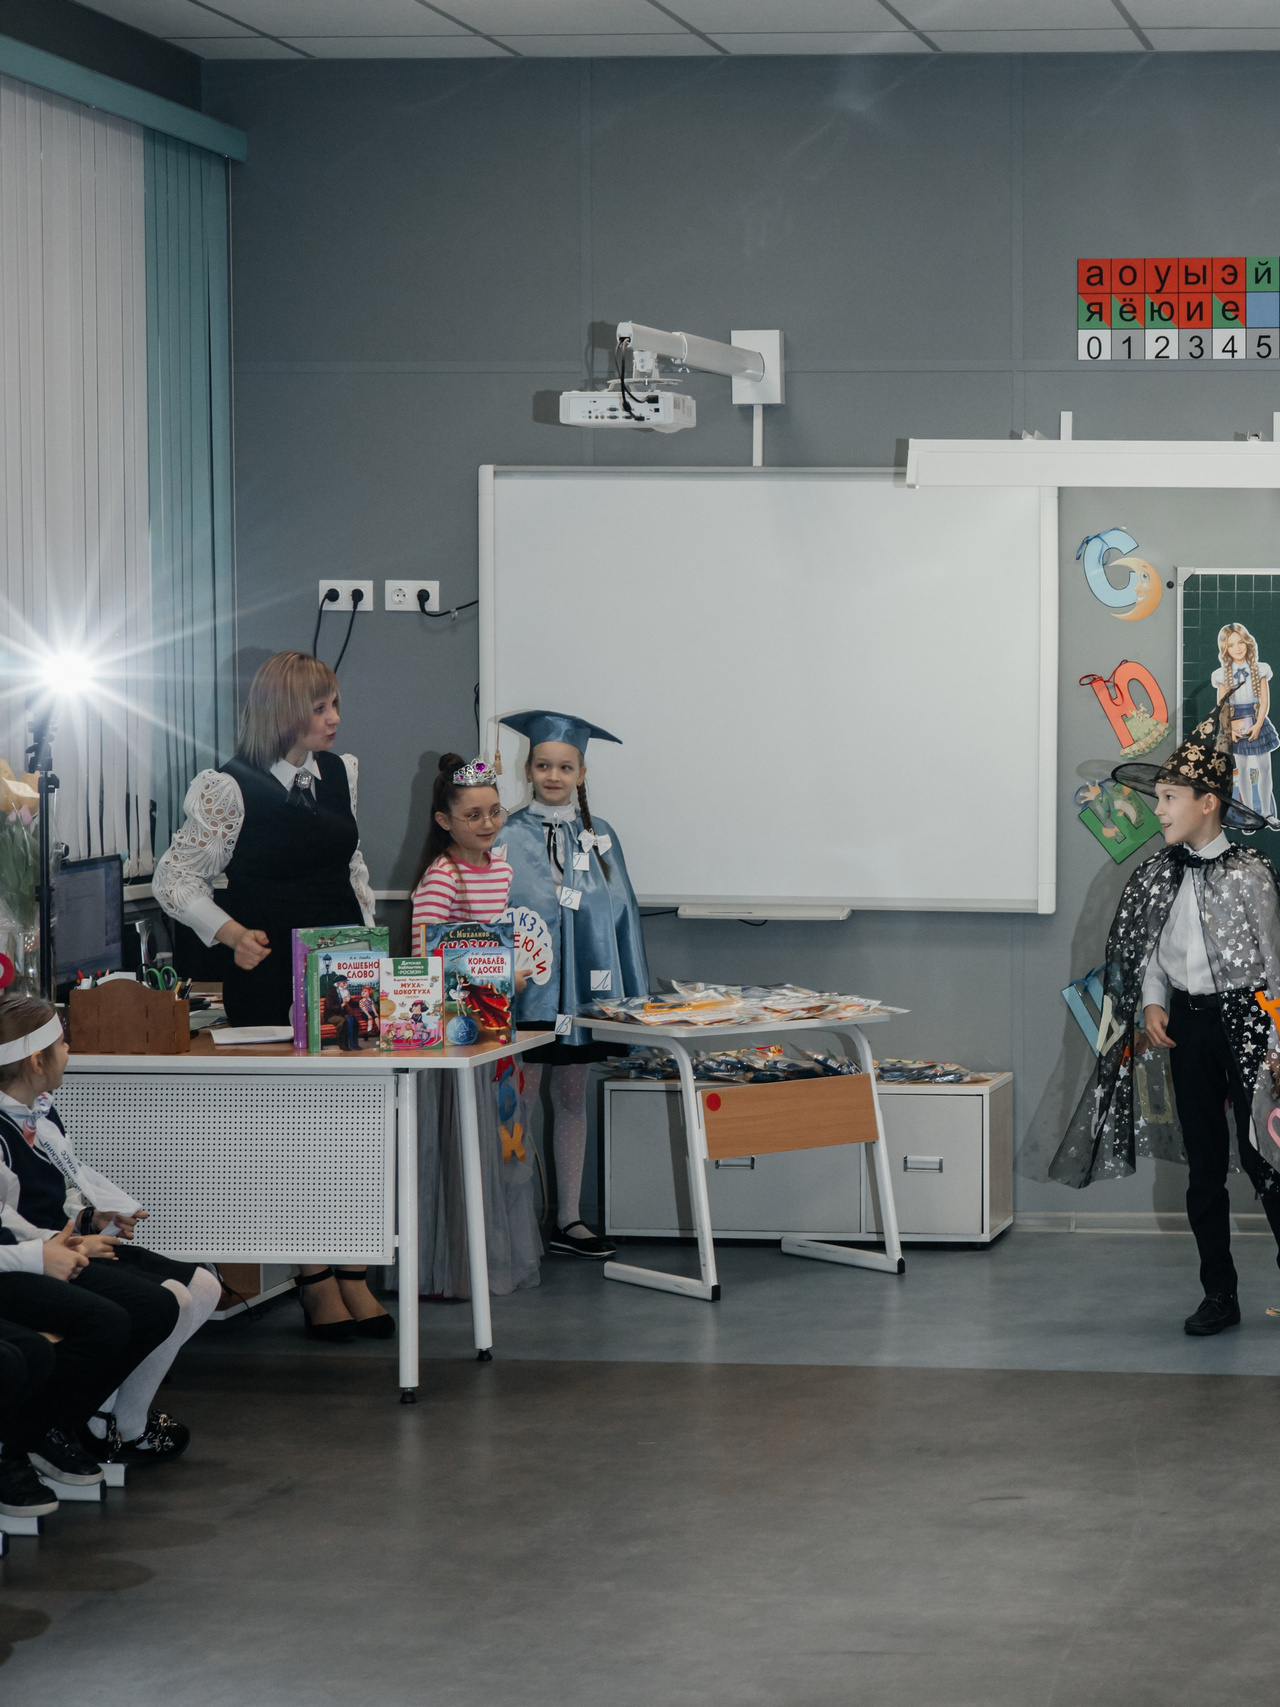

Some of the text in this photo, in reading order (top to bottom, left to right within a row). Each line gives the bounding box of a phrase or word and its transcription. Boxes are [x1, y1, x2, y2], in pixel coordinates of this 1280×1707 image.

[1085, 265, 1104, 287] а
[1118, 265, 1138, 286] о
[1154, 265, 1172, 292] у
[1184, 264, 1207, 286] ы
[1221, 264, 1238, 286] э
[1254, 260, 1272, 285] й
[1085, 302, 1103, 322] я
[1118, 298, 1137, 323] ё
[1150, 301, 1175, 322] ю
[1186, 301, 1204, 322] и
[1221, 300, 1240, 322] е
[1086, 336, 1102, 360] 0
[1122, 335, 1132, 360] 1
[1154, 335, 1170, 359] 2
[1188, 335, 1205, 360] 3
[1221, 335, 1238, 359] 4
[1256, 334, 1272, 359] 5
[467, 956, 507, 966] КОРАБЛЁВ,
[346, 969, 375, 979] СЛОВО
[477, 966, 504, 975] ДОСКЕ!
